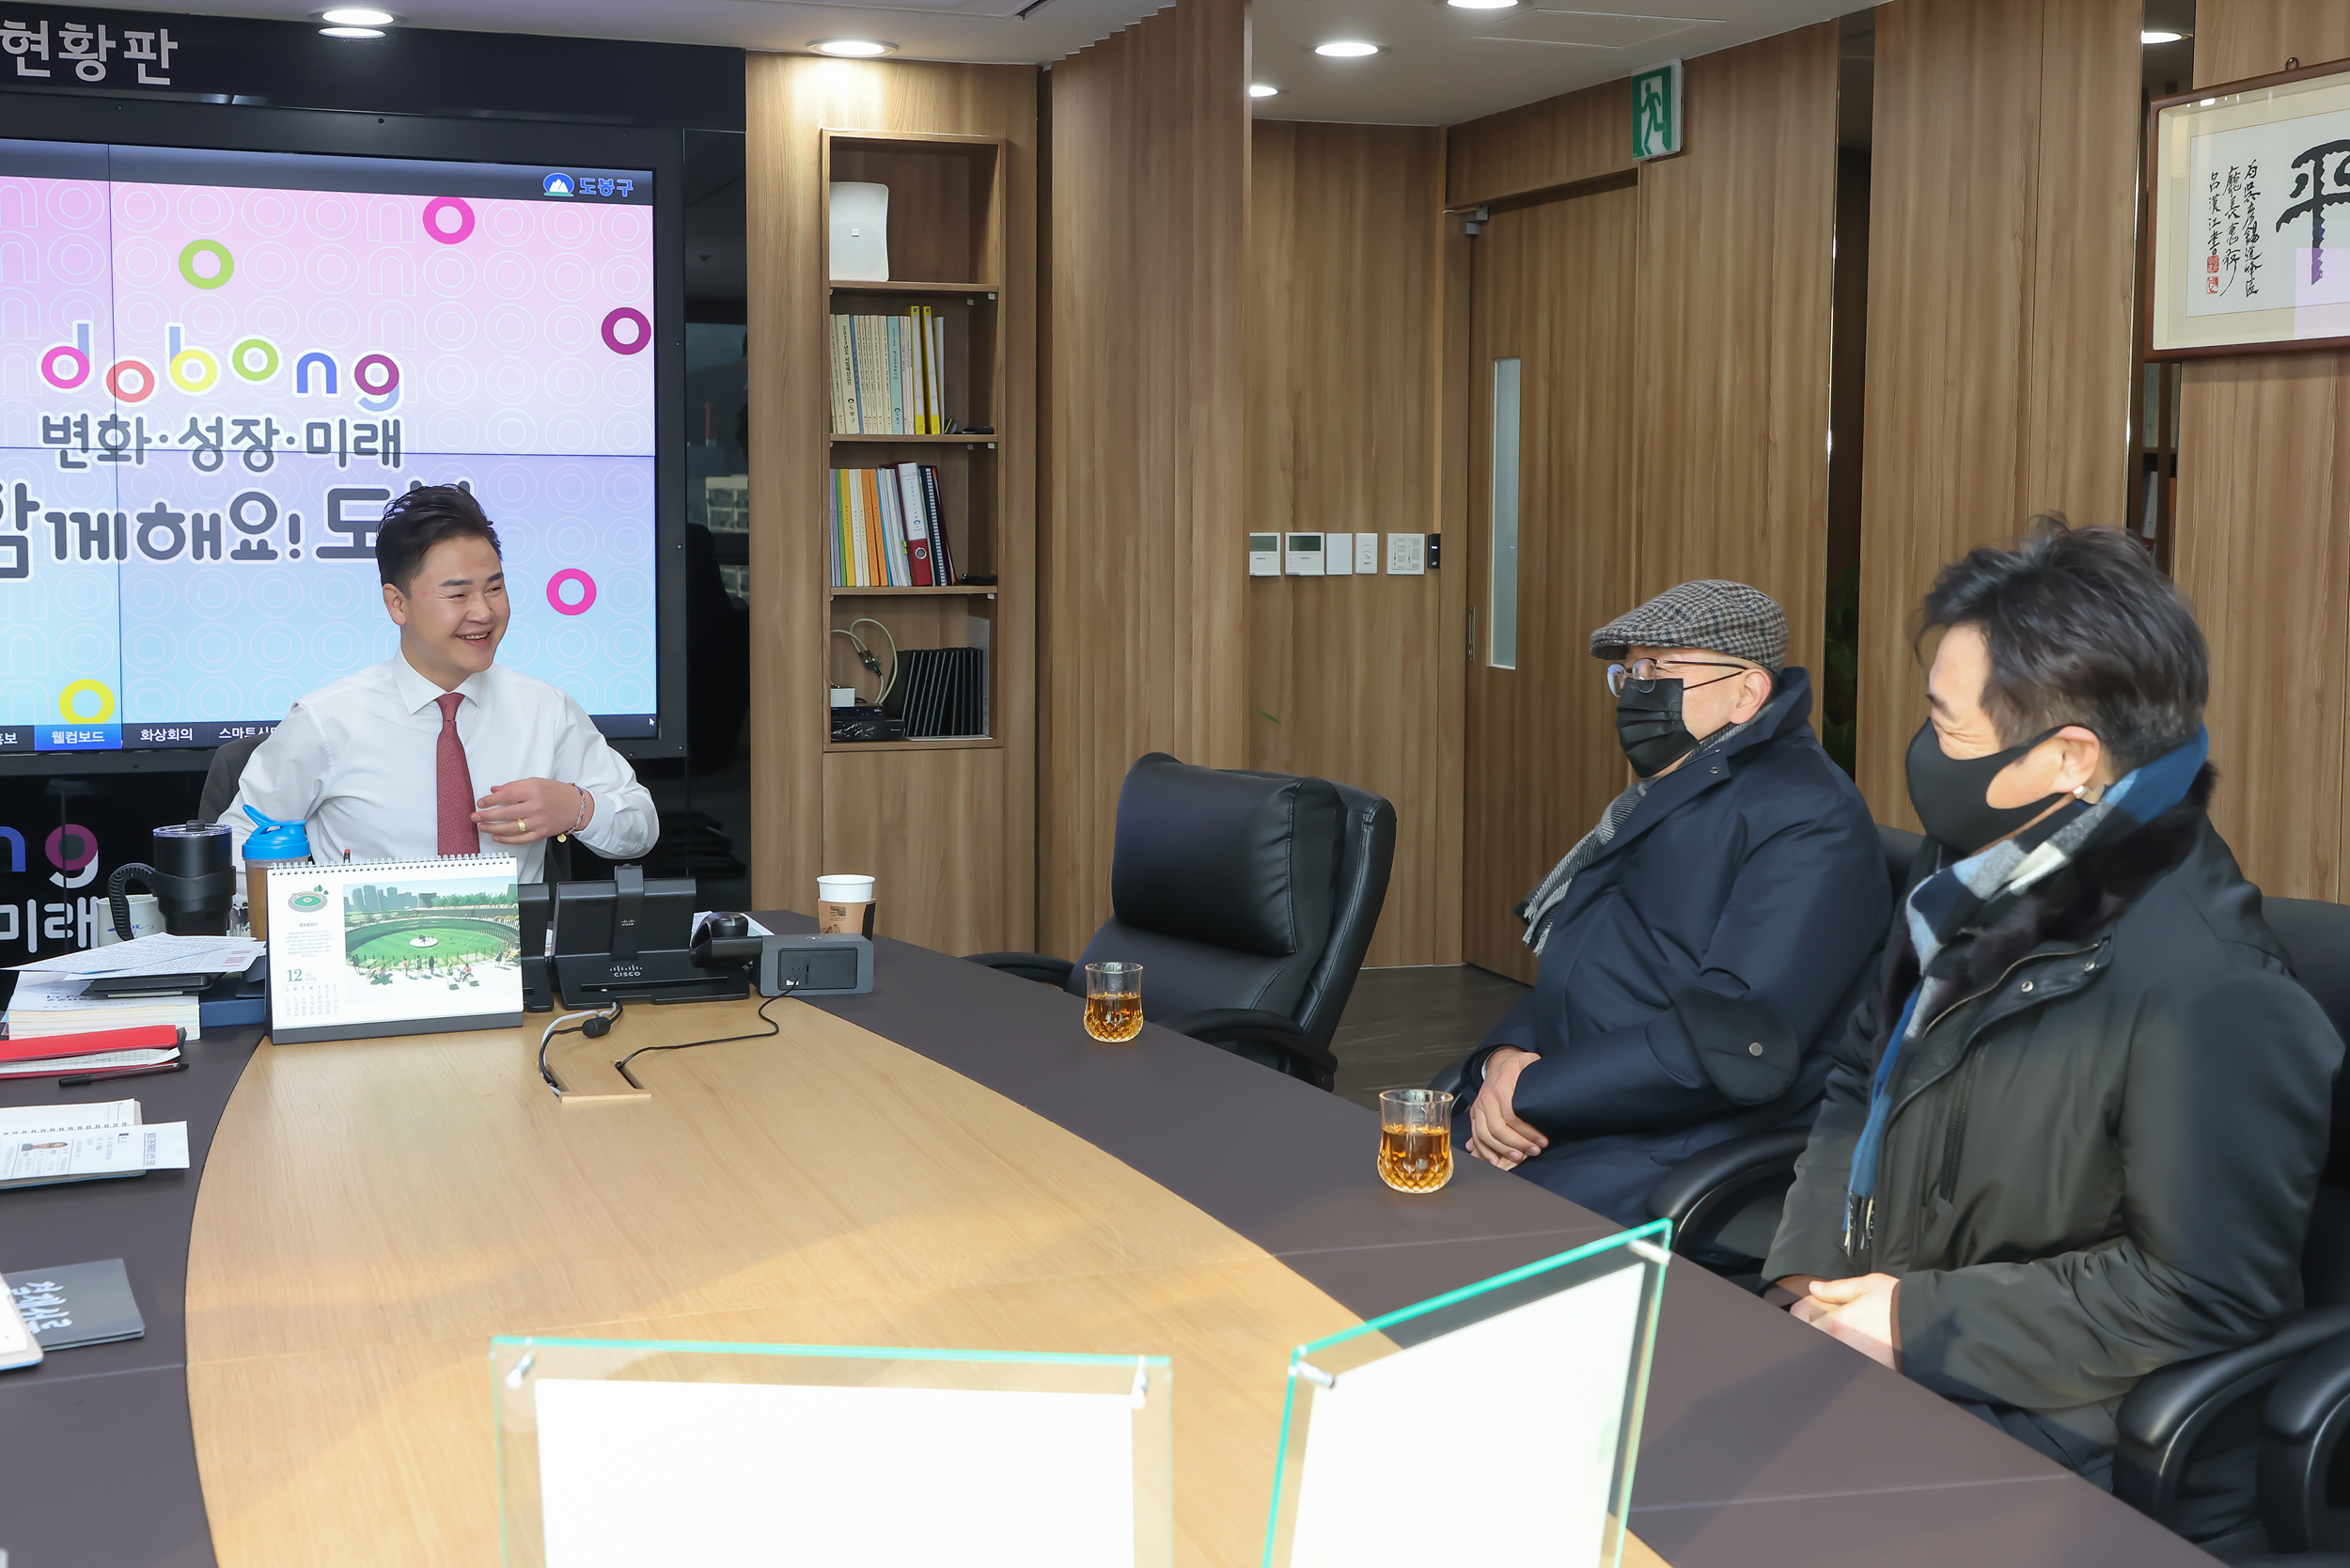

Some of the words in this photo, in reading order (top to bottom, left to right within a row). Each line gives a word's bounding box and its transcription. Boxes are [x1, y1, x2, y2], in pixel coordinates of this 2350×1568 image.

[0, 19, 179, 86] 현황판
[578, 177, 634, 197] 도봉구
[39, 321, 402, 414] dobong
[51, 729, 105, 745] 웰컴보드
[139, 728, 194, 742] 화상회의
[286, 968, 303, 982] 12
